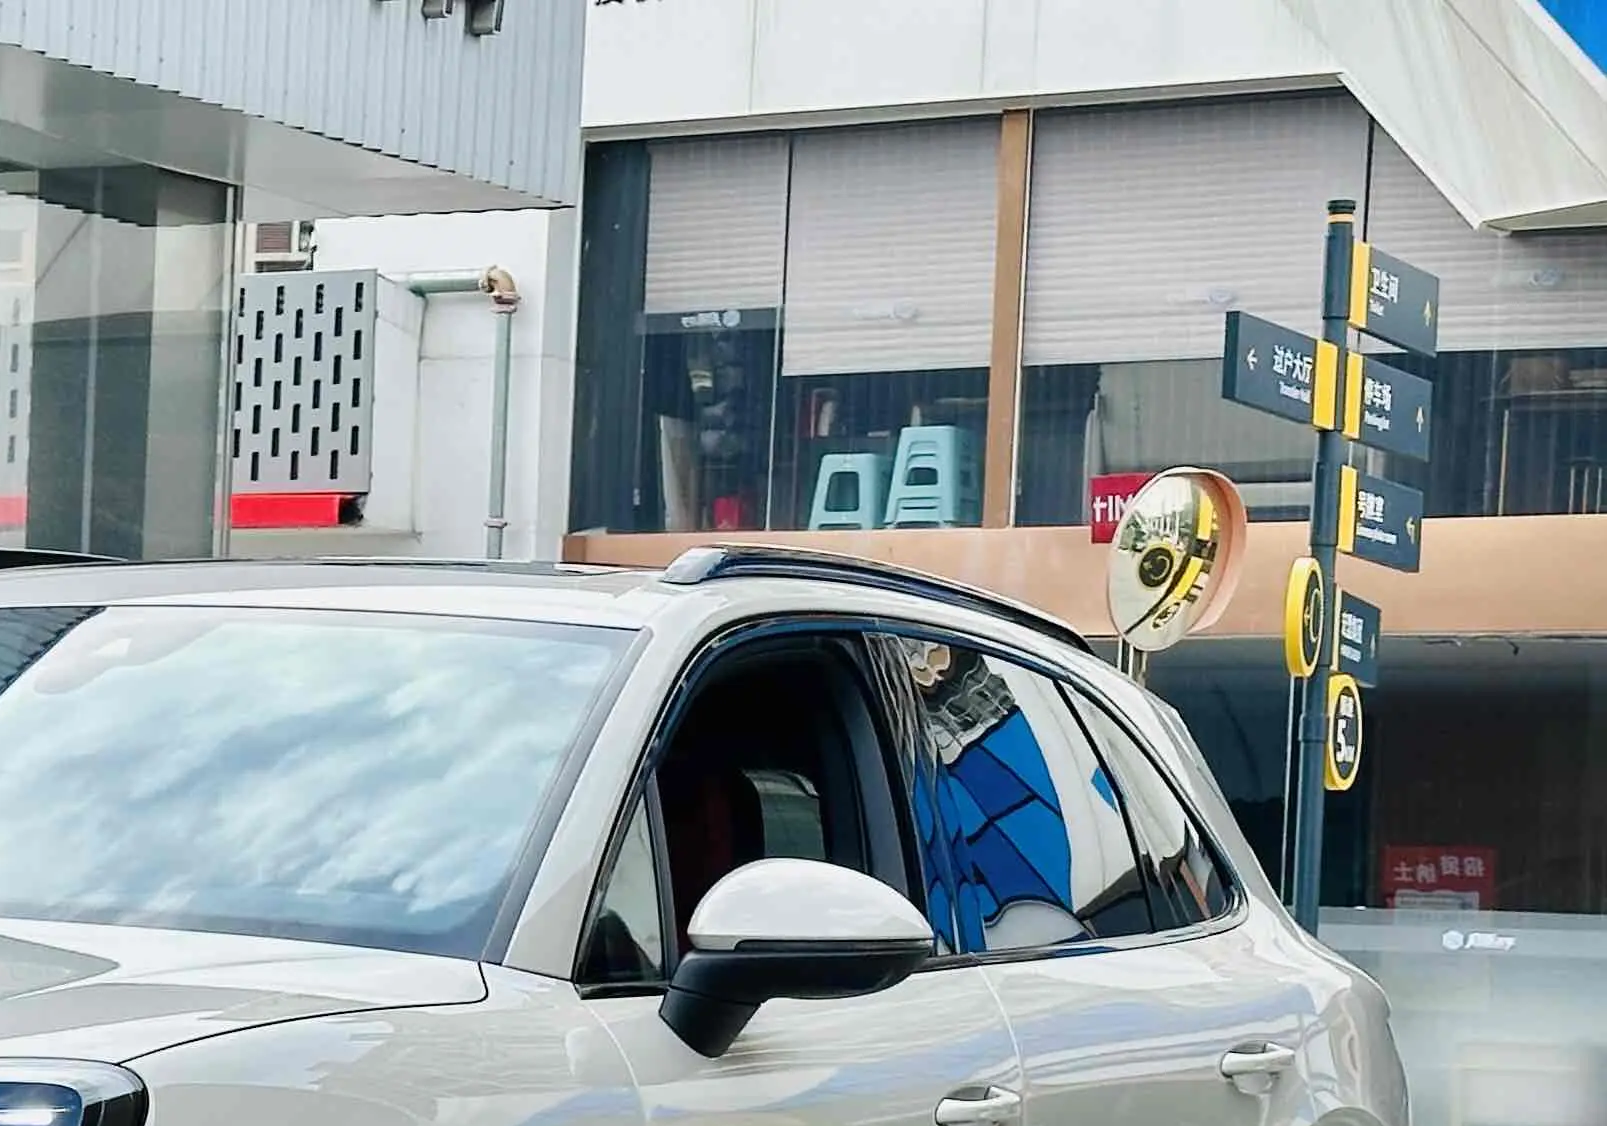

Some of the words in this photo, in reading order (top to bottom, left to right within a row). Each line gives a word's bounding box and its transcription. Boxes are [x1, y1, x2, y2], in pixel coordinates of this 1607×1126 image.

[1370, 267, 1399, 304] 卫生间
[1335, 719, 1348, 762] 5
